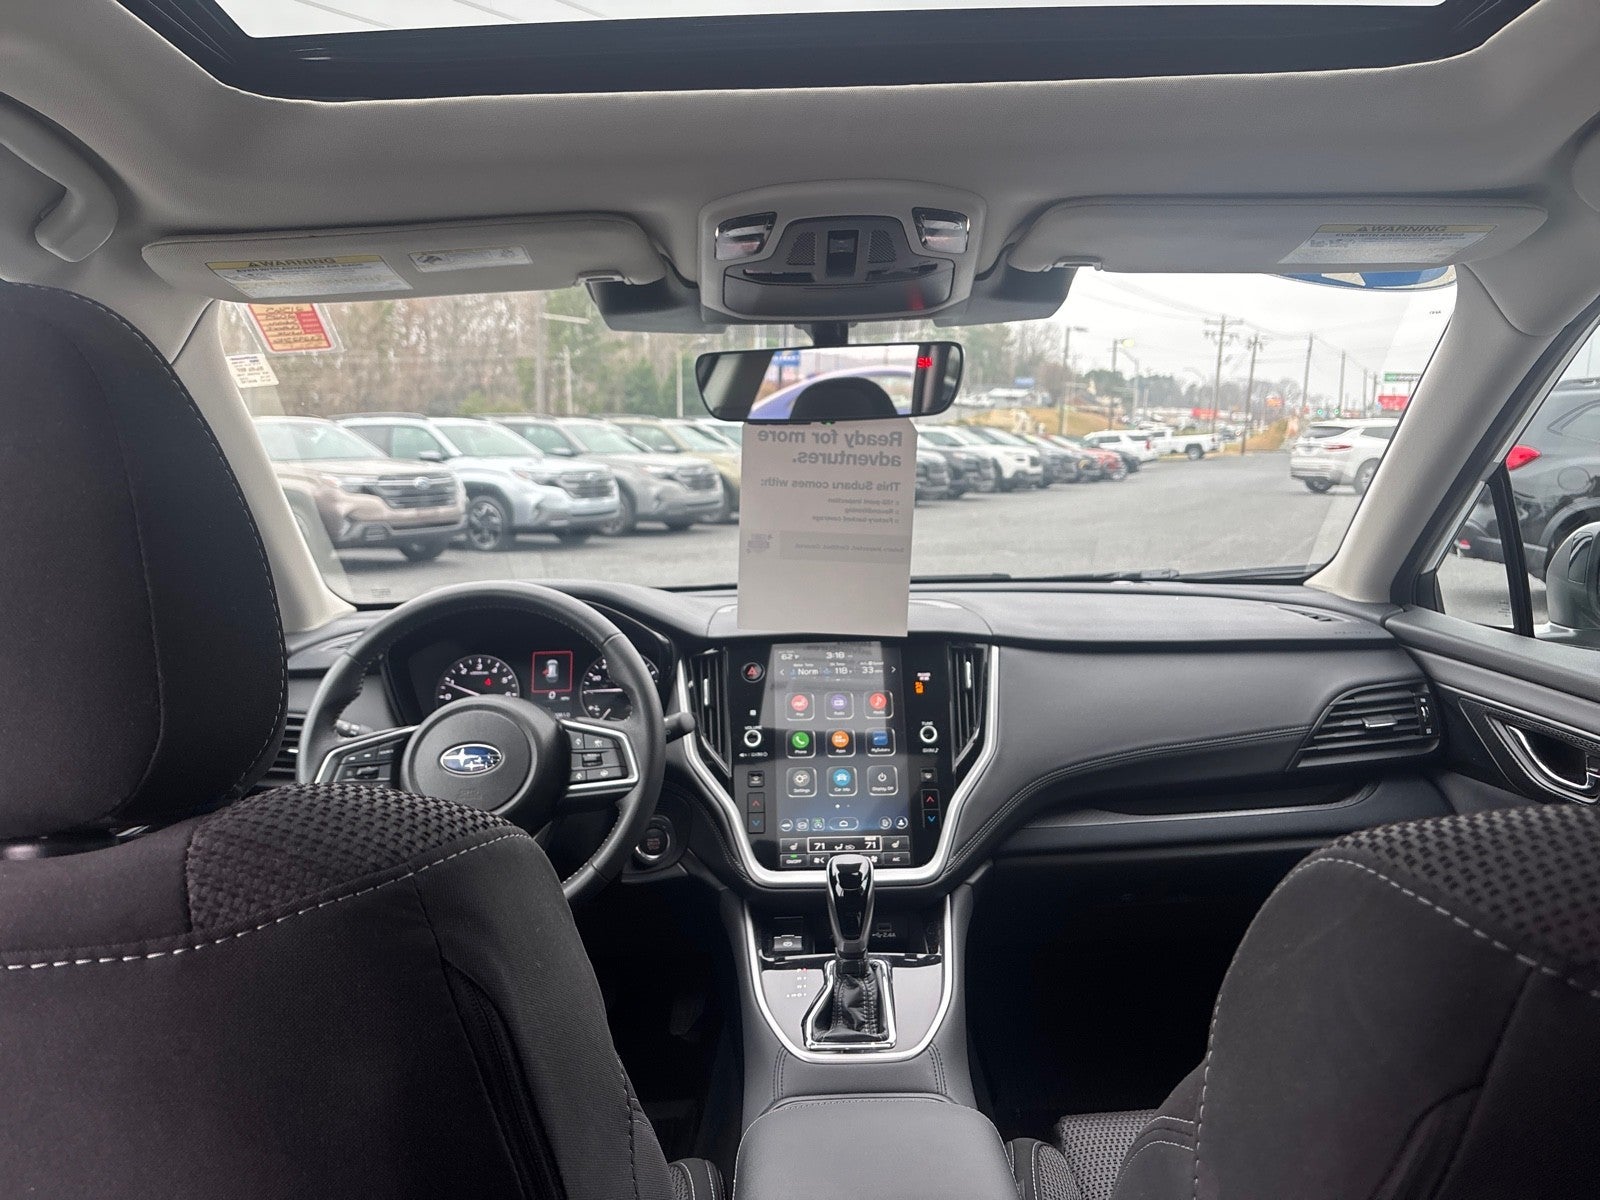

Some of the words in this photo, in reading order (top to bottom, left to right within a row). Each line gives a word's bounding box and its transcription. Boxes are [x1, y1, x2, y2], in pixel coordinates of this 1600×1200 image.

[1368, 225, 1447, 233] WARNING
[260, 257, 336, 267] WARNING
[862, 666, 874, 674] 33
